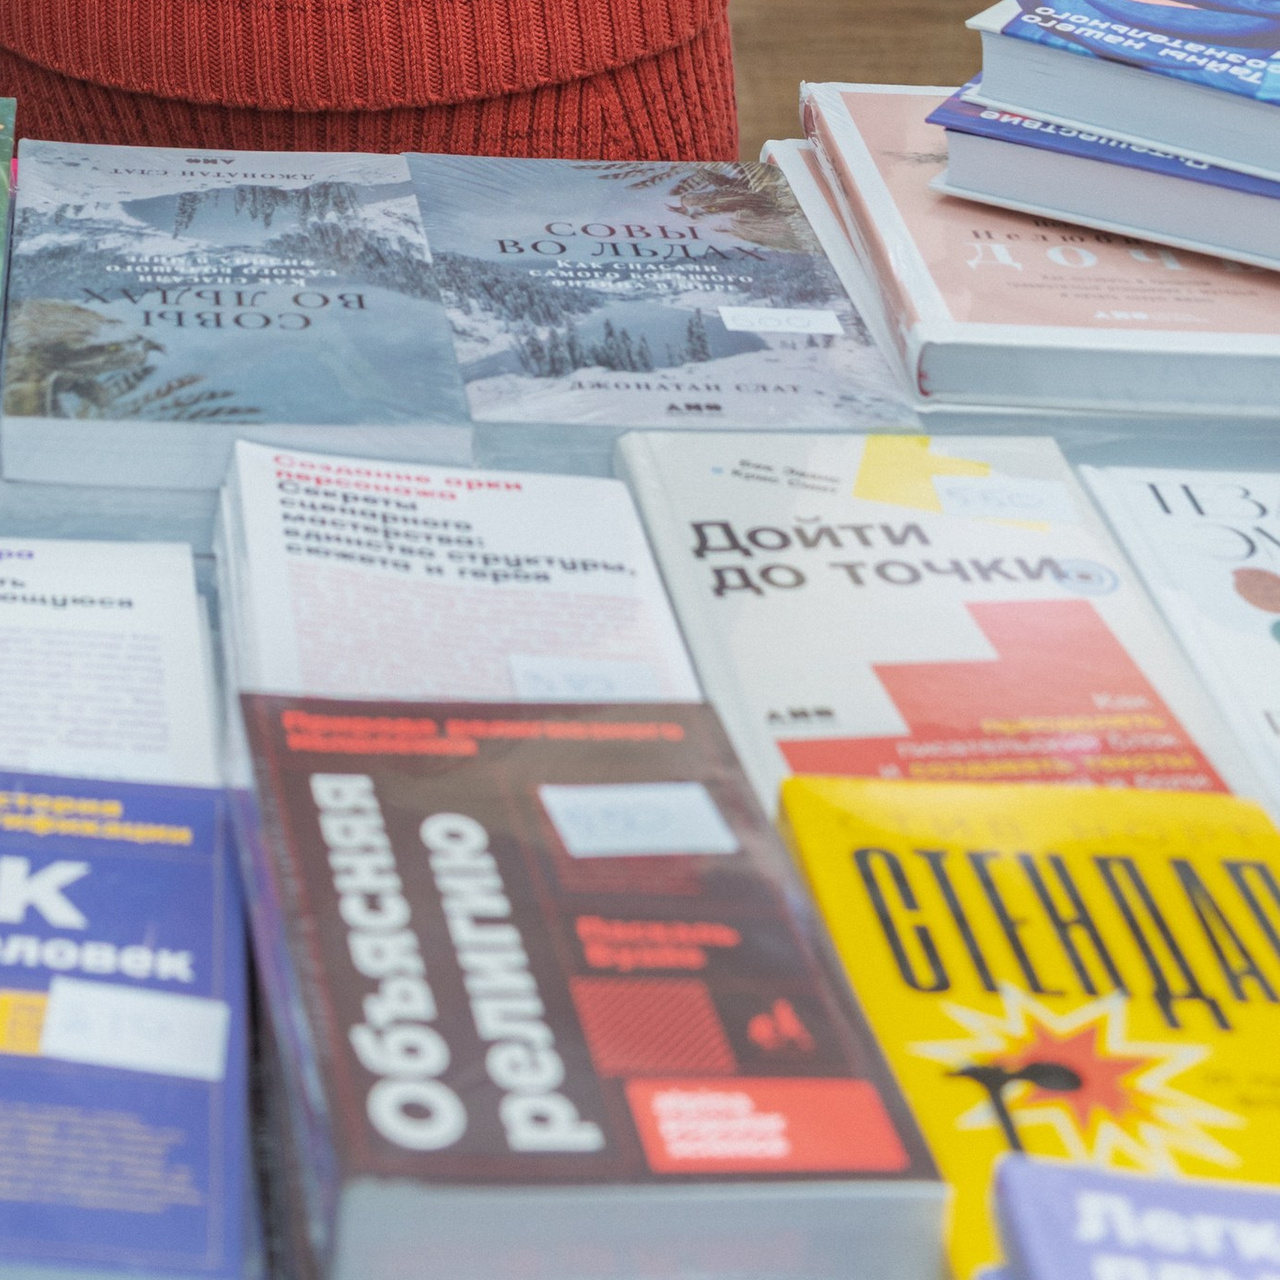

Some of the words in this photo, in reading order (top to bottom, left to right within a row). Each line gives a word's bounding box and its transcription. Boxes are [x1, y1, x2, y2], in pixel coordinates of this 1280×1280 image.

[1021, 13, 1146, 50] нашего
[1034, 6, 1280, 74] сознательного
[1158, 47, 1263, 85] Тайны
[544, 221, 704, 240] СОВЫ
[497, 239, 568, 256] ВО
[590, 241, 768, 262] ЛЬДАХ
[81, 287, 268, 308] ЛЬДАХ
[292, 291, 368, 310] ВО
[142, 310, 312, 331] СОВЫ
[691, 514, 932, 558] Дойти
[711, 564, 807, 598] до
[829, 555, 1071, 589] точки
[309, 772, 468, 1150] Объясняя
[420, 812, 606, 1152] религию
